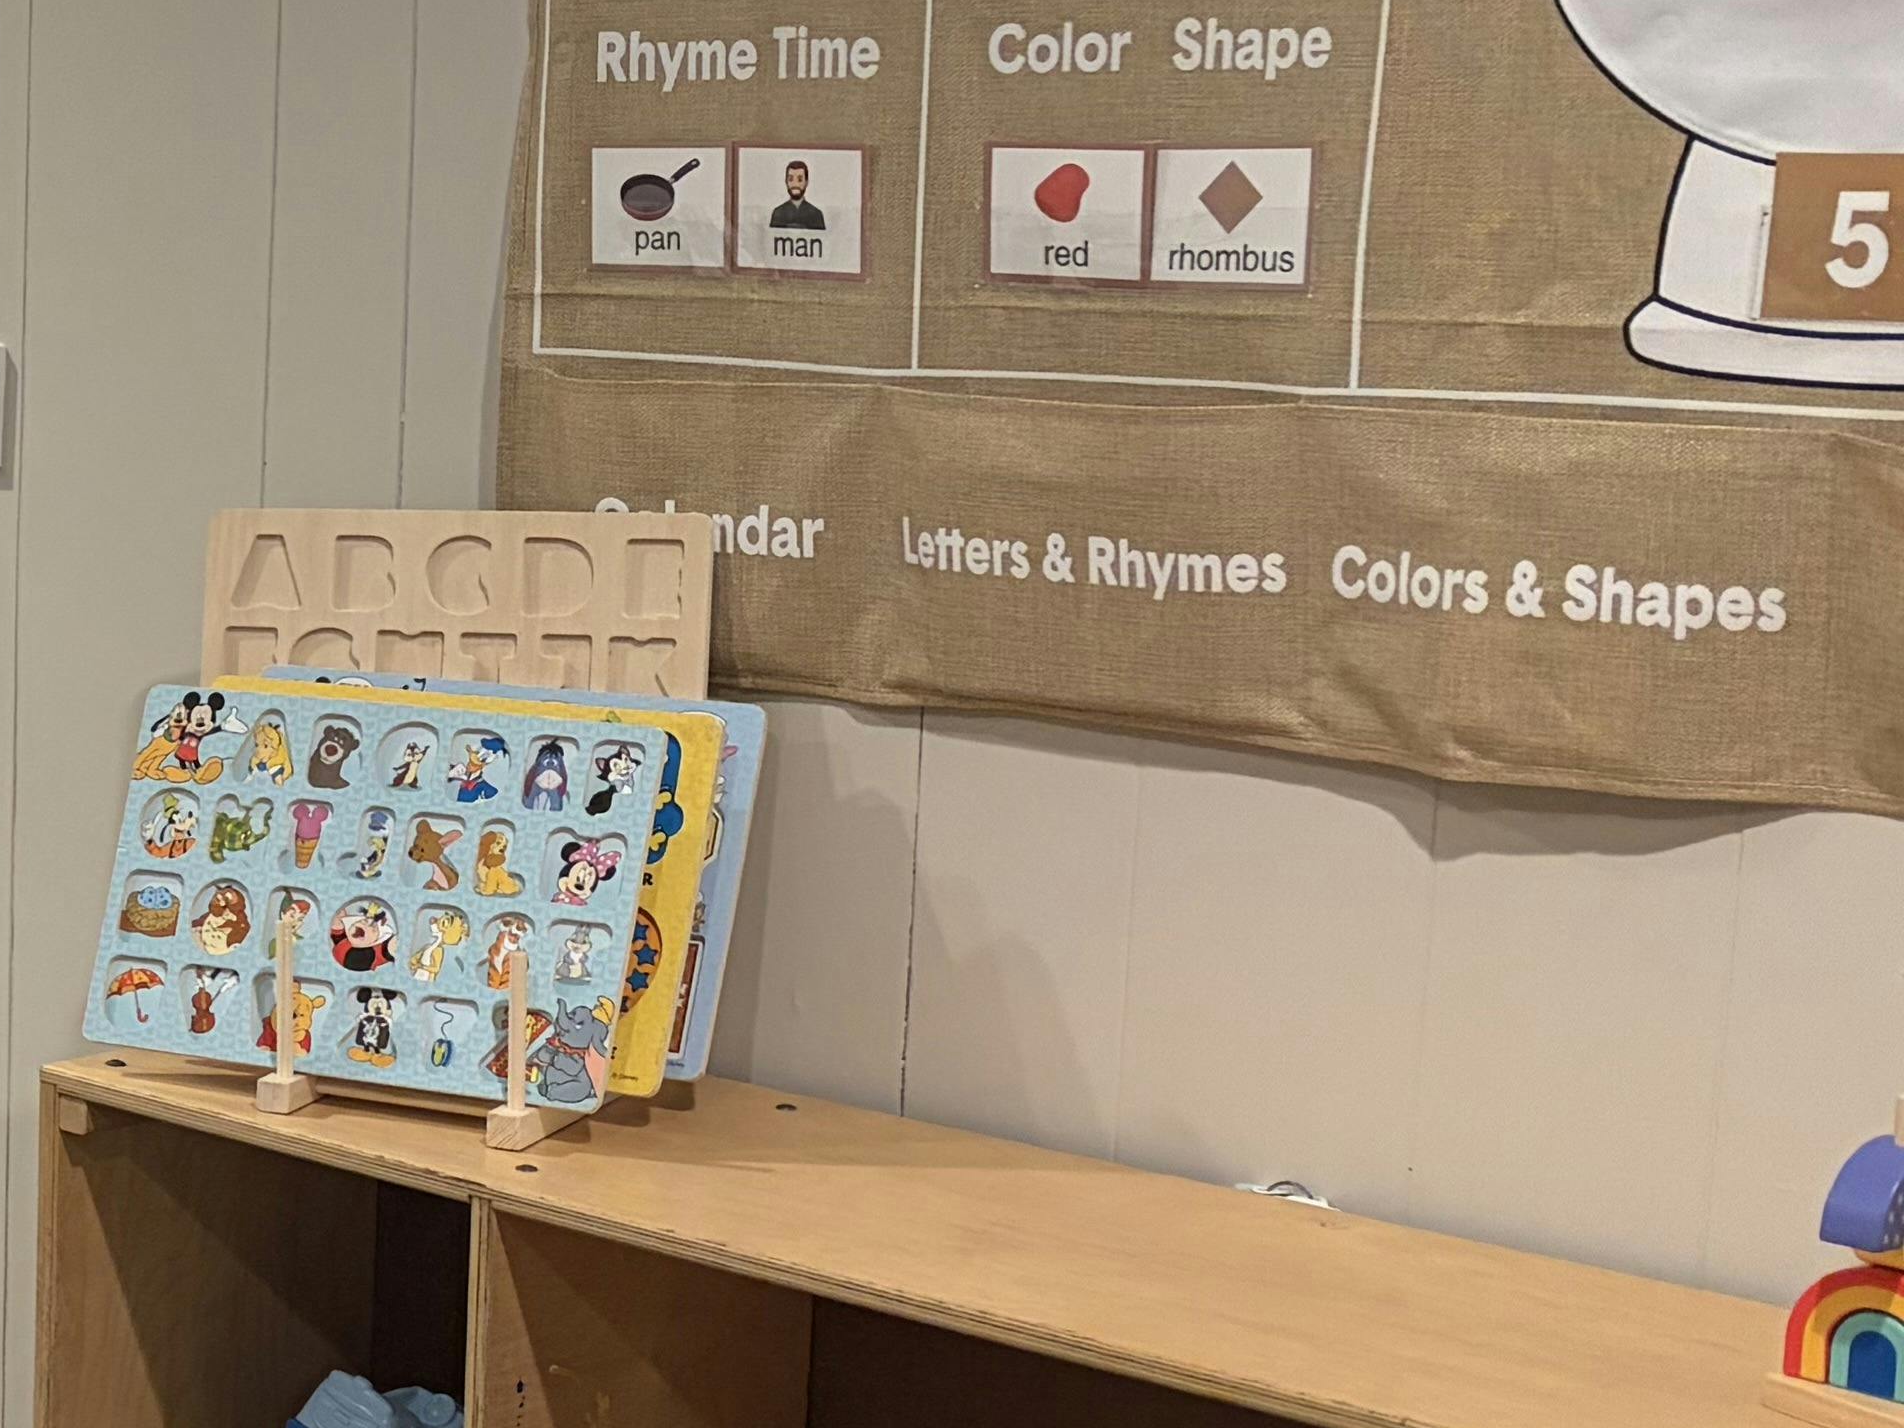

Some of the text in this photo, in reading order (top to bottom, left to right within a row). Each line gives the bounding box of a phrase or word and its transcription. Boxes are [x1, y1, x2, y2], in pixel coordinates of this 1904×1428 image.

[595, 25, 881, 93] Rhyme Time
[988, 22, 1133, 76] Color
[1171, 18, 1333, 81] Shape
[634, 227, 682, 257] pan
[773, 234, 824, 259] man
[1044, 241, 1090, 270] red
[1167, 243, 1295, 276] rhombus
[1824, 190, 1890, 288] 5
[521, 537, 594, 619] D
[901, 515, 1288, 601] Letters & Rhymes
[1331, 544, 1787, 640] Colors & Shapes
